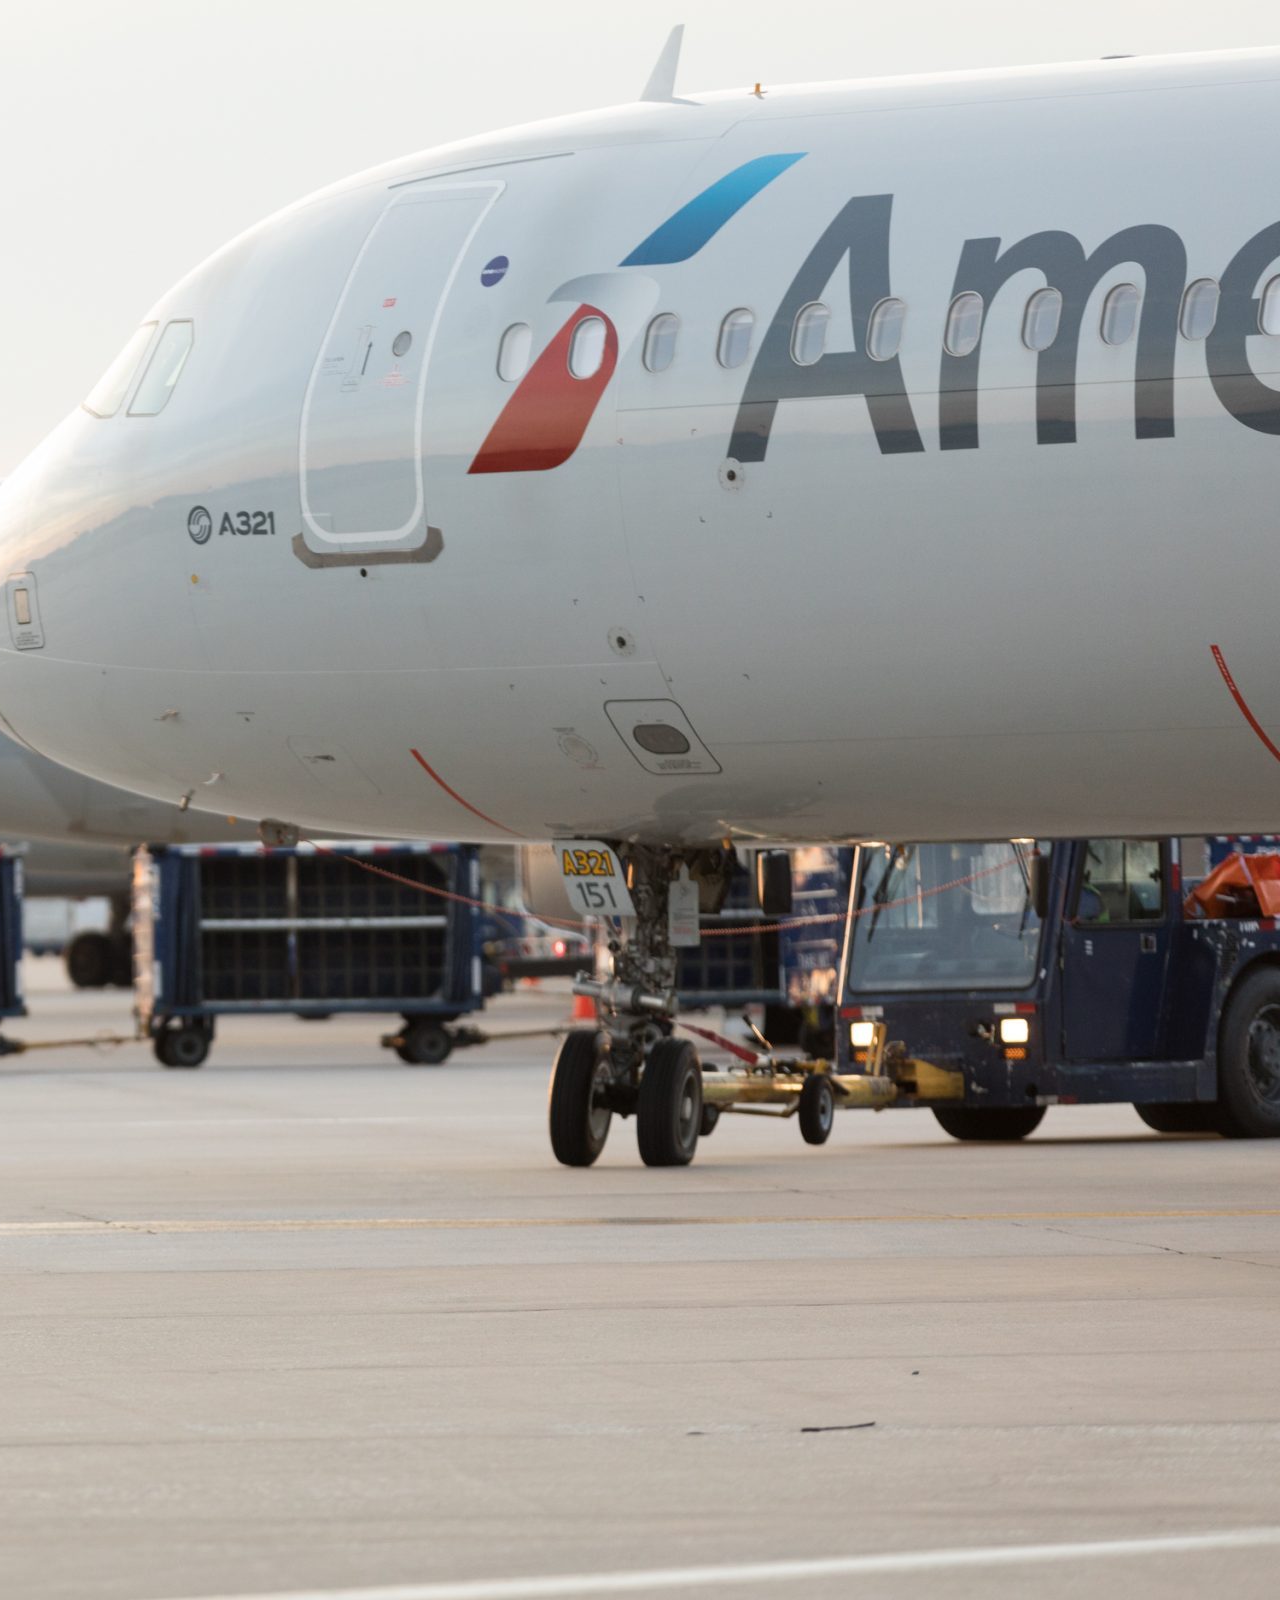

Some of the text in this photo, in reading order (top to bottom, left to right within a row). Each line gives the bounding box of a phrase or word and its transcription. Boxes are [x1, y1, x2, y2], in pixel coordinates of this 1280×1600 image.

[219, 510, 276, 536] A321
[563, 849, 616, 876] A321
[576, 881, 618, 908] 151
